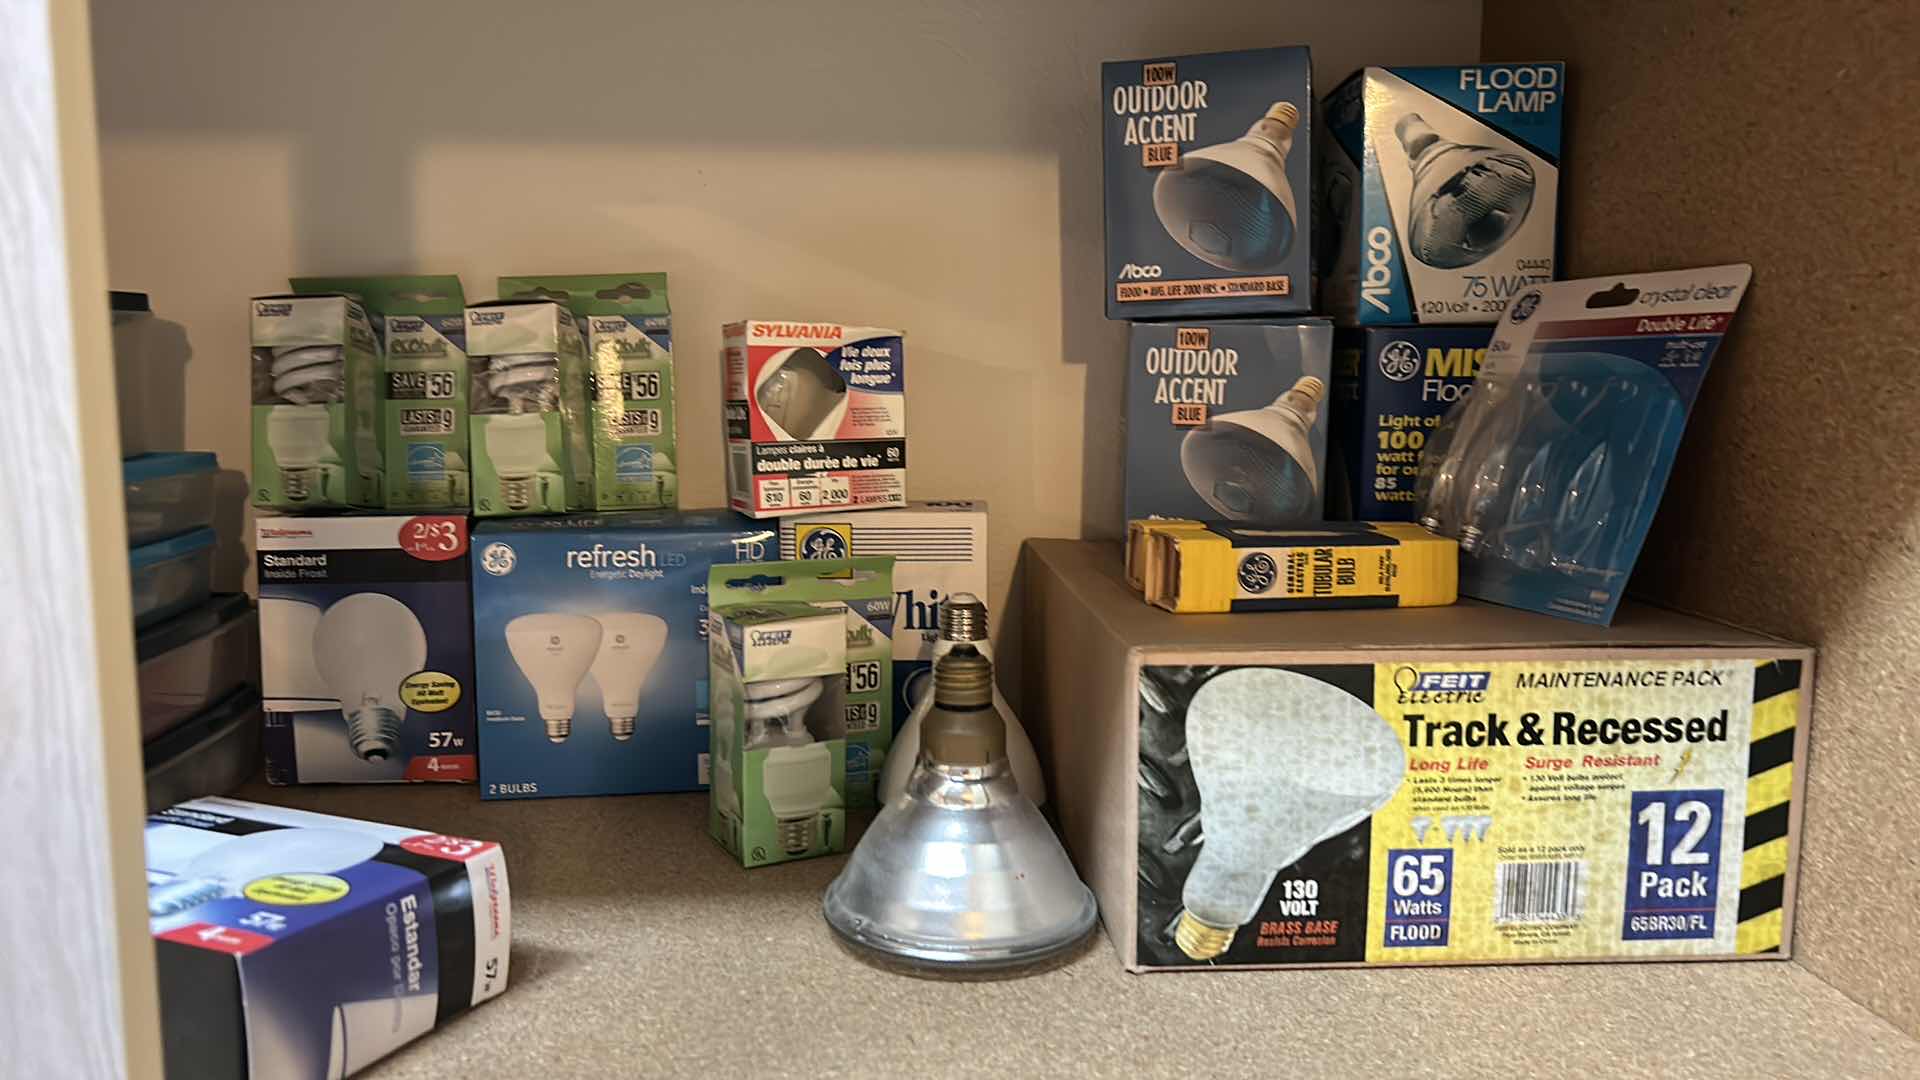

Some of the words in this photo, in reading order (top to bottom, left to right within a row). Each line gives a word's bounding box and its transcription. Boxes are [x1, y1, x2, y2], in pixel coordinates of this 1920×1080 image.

[1459, 67, 1558, 91] FLOOD
[1113, 81, 1208, 115] OUTDOOR
[1478, 91, 1557, 113] LAMP
[1124, 113, 1198, 146] ACCENT
[1148, 146, 1173, 163] BLUE
[1462, 275, 1488, 298] 75
[752, 323, 843, 340] SYLVANIA
[1637, 317, 1687, 333] Double
[1179, 331, 1206, 347] 100W
[841, 346, 859, 358] Vie
[861, 346, 891, 358] deux
[864, 359, 891, 373] plus
[1146, 347, 1238, 376] OUTDOOR
[1425, 348, 1486, 377] MIS
[392, 373, 426, 389] SAVE
[1154, 378, 1227, 404] ACCENT
[1177, 406, 1201, 421] BLUE
[1379, 415, 1421, 430] Light
[1423, 415, 1440, 427] of
[1377, 431, 1424, 449] 100
[757, 459, 801, 472] double
[803, 456, 840, 469] durée
[842, 455, 858, 468] de
[1374, 477, 1397, 490] 85
[566, 543, 657, 569] refresh
[736, 541, 766, 560] HD
[264, 554, 328, 567] Standard
[1313, 548, 1333, 597] TUBULAR
[1336, 558, 1356, 585] BULB
[1421, 673, 1485, 689] FEIT
[1516, 670, 1668, 689] MAINTENANCE
[1671, 669, 1723, 687] PACK
[1403, 713, 1511, 748] Track
[1517, 712, 1545, 747] &
[1553, 709, 1729, 745] Recessed
[1409, 758, 1451, 773] Long
[1457, 757, 1489, 770] Life
[1525, 756, 1573, 771] Surge
[1582, 754, 1661, 768] Resistant
[489, 783, 497, 795] 2
[499, 782, 538, 794] BULBS
[1638, 800, 1712, 865] 12
[1393, 854, 1445, 896] 65
[1282, 880, 1318, 899] 130
[1639, 870, 1708, 899] Pack
[1280, 900, 1319, 916] VOLT
[1393, 899, 1442, 916] Watts
[1260, 921, 1303, 935] BRASS
[1305, 920, 1339, 934] BASE
[1390, 924, 1441, 941] FLOOD
[400, 893, 423, 993] Estandar
